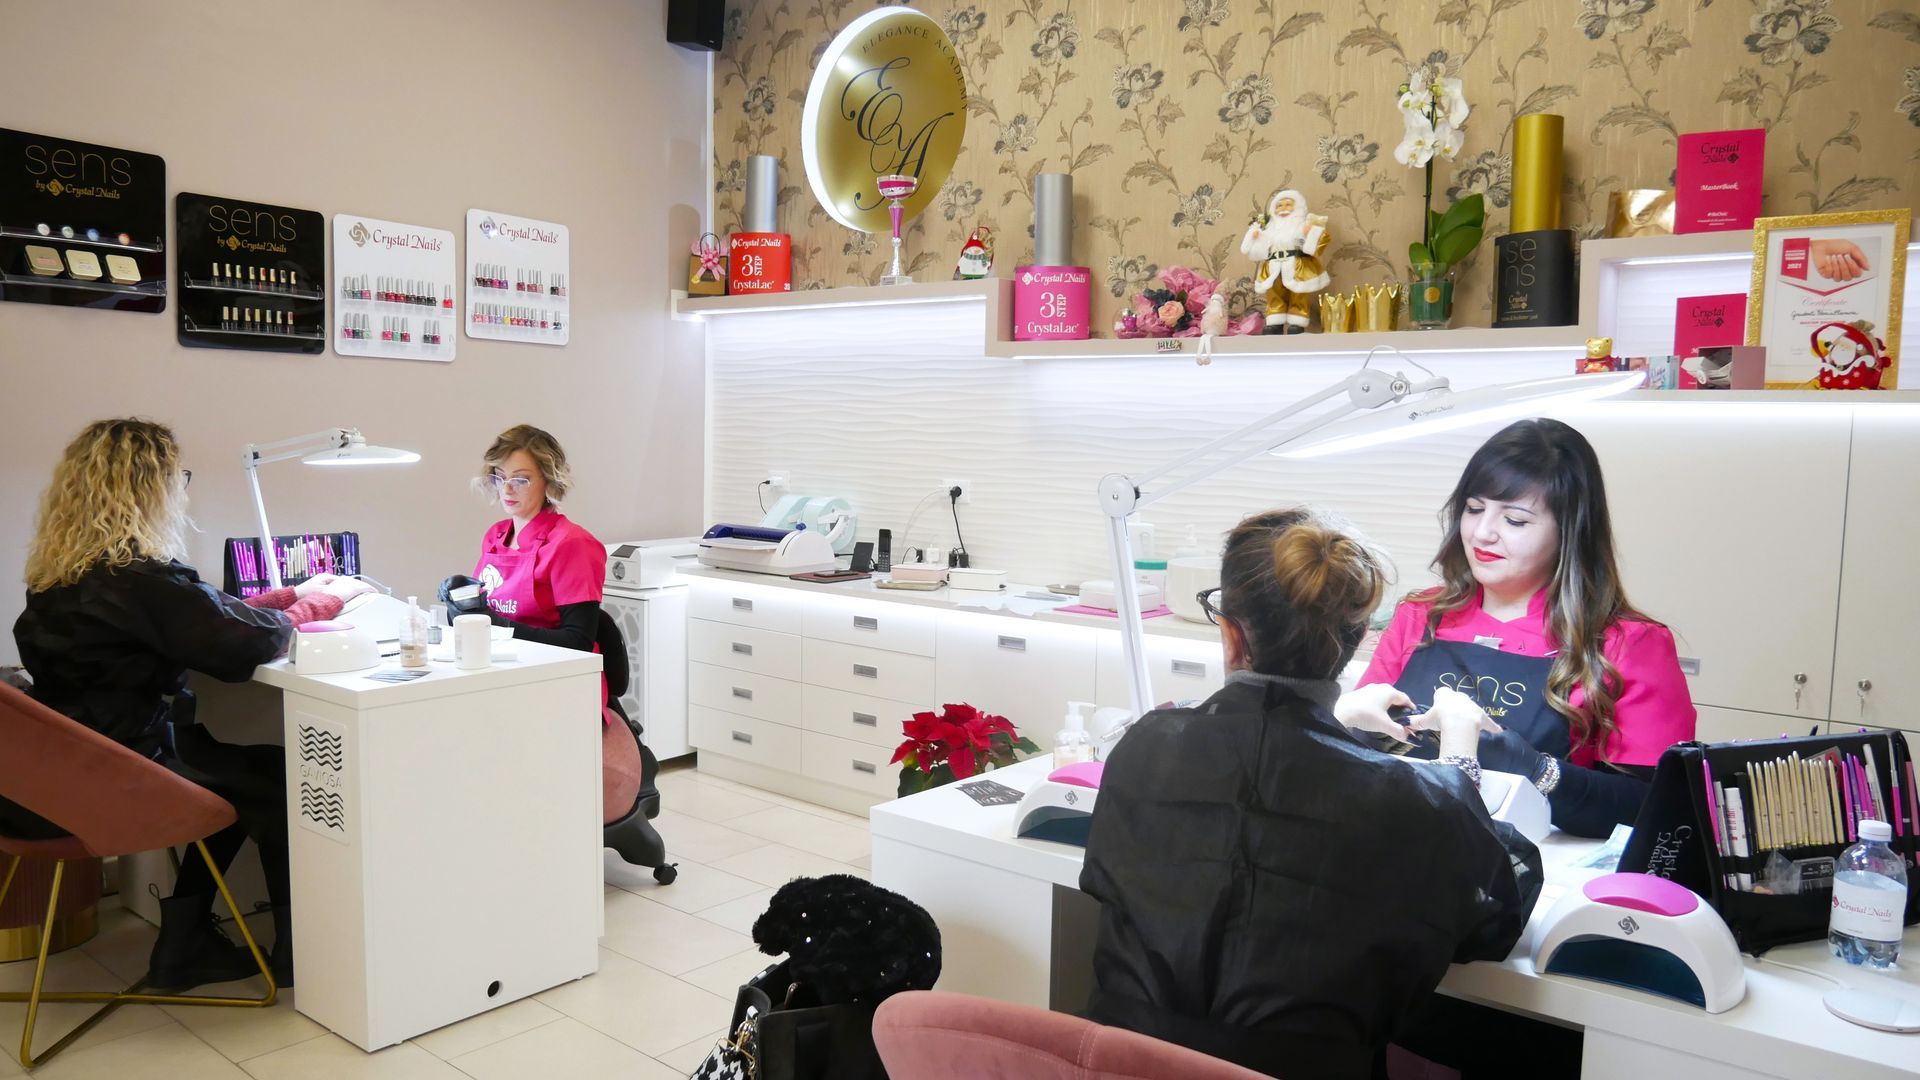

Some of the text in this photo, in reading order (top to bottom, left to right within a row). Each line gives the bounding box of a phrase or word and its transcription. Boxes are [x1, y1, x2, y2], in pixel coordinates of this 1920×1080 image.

[862, 25, 968, 110] ELEGANCE ACADEMY
[1700, 140, 1741, 156] Crystal
[25, 144, 132, 186] sens
[36, 179, 121, 199] by Crystal Nails
[208, 204, 297, 241] sens
[372, 229, 442, 252] Crystal Nails
[499, 222, 558, 244] Crystal Nails
[241, 240, 266, 252] Crystal
[266, 242, 287, 253] Nails
[737, 238, 782, 249] Crystal Nails
[741, 254, 763, 277] 3 STEP
[733, 279, 775, 292] CrystaLac
[1033, 272, 1086, 286] Crystal Nails
[1039, 291, 1067, 319] 3 STEP
[1692, 304, 1725, 320] Crystal
[1027, 321, 1079, 337] CrystaLac
[491, 598, 518, 615] Nails
[1647, 831, 1673, 870] Nails
[1661, 824, 1694, 880] Crysta
[1840, 900, 1893, 918] Crystal Nails
